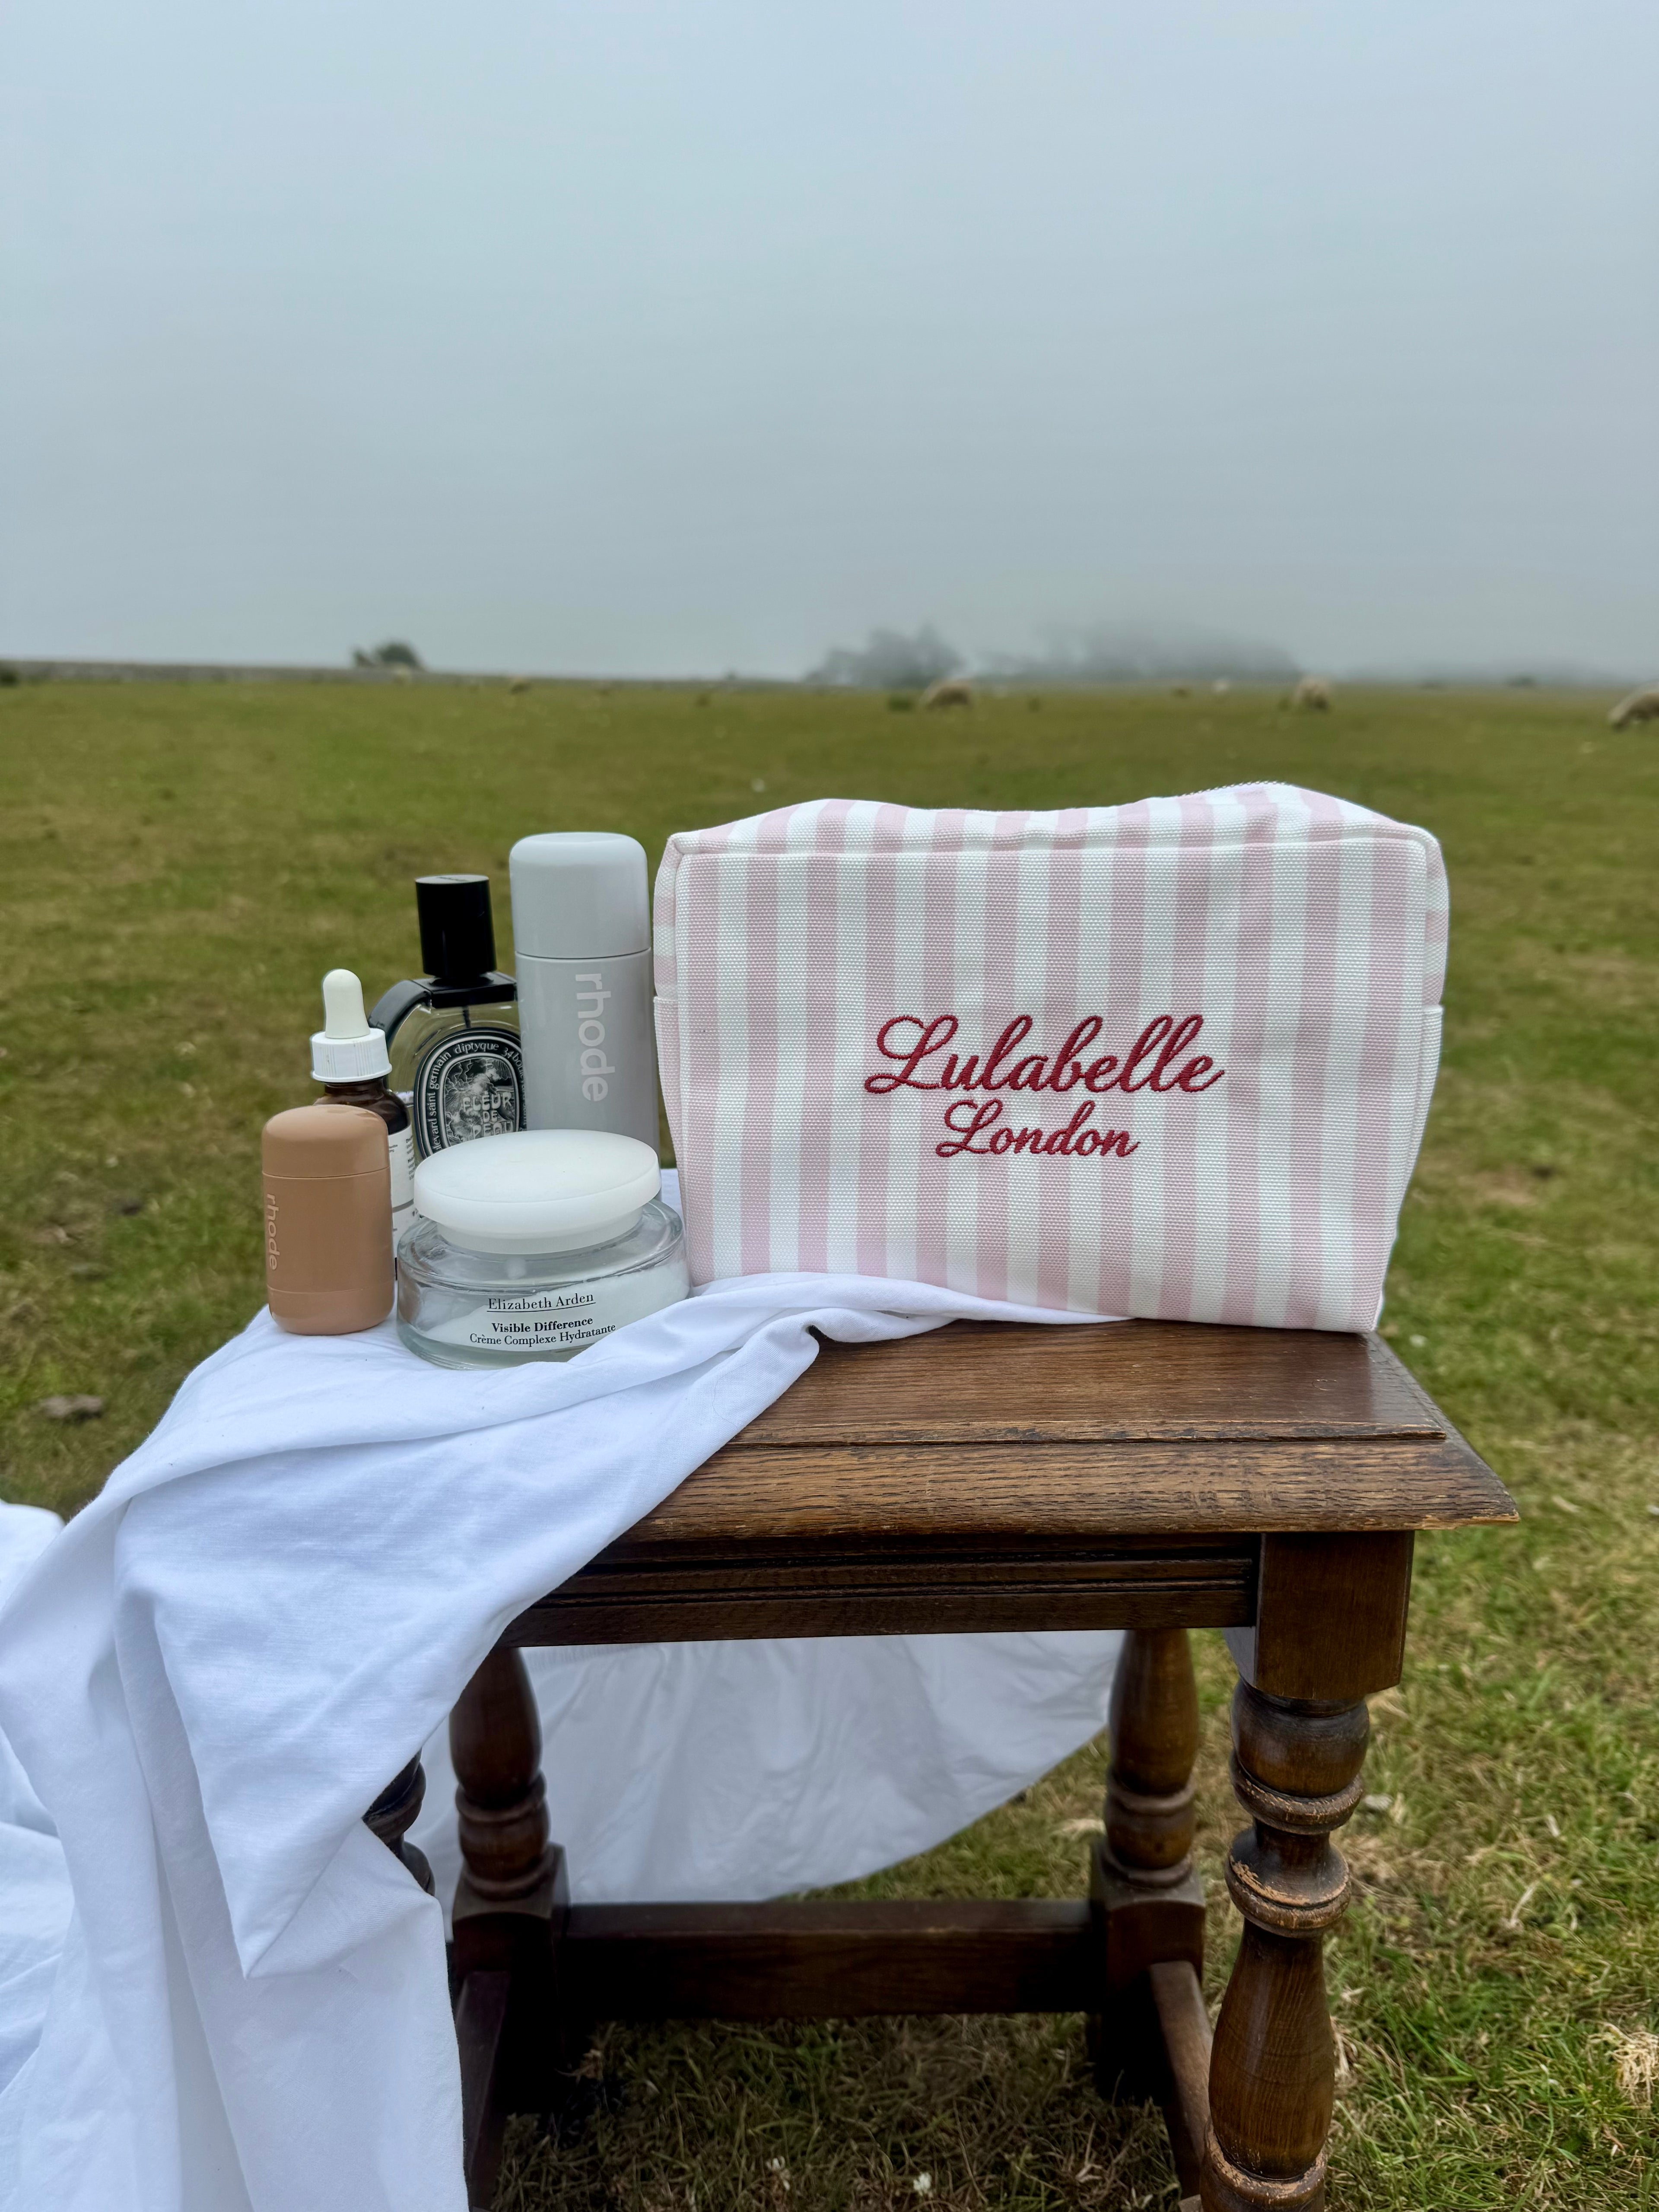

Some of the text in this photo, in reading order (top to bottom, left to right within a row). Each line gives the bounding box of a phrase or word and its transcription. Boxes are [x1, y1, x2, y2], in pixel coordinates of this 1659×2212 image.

[454, 1042, 499, 1054] diptyque
[575, 973, 616, 1103] rhode
[502, 1047, 514, 1059] 34
[864, 1014, 1225, 1095] Lulabelle
[429, 1051, 451, 1090] germain
[427, 1092, 437, 1116] saint
[463, 1091, 512, 1112] FLEUR
[483, 1109, 498, 1123] DE
[472, 1121, 514, 1139] PEAU
[935, 1098, 1141, 1157] London
[267, 1193, 280, 1271] rhode
[488, 1294, 594, 1310] Elizabeth Arden
[491, 1316, 593, 1333] Visible Difference
[470, 1325, 616, 1347] Crème Complexe Hydratante
